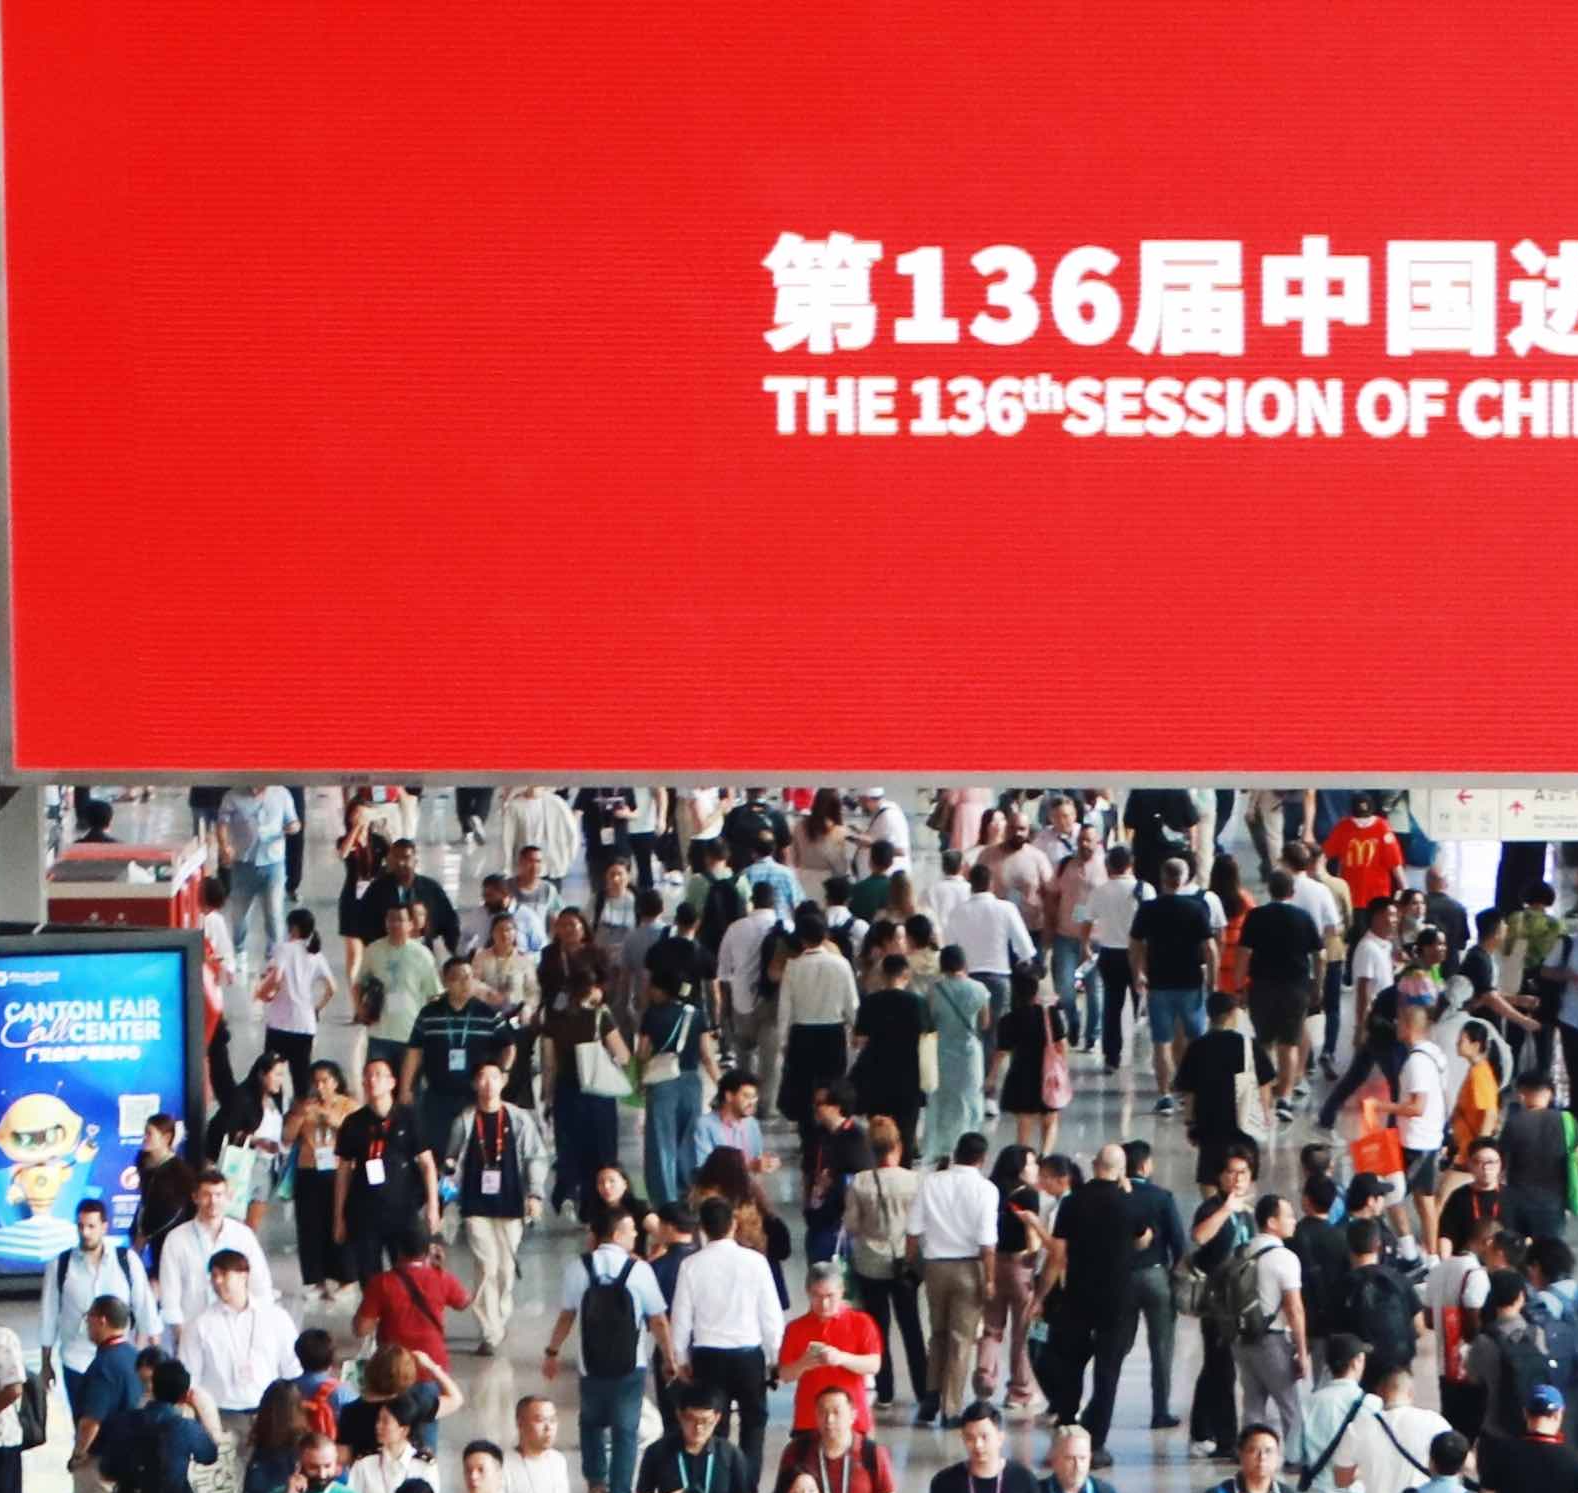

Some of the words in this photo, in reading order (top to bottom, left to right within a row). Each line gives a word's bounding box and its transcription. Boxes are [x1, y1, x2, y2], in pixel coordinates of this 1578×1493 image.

[764, 376, 899, 437] THE
[1357, 377, 1449, 438] OF
[4, 999, 104, 1024] CANTON
[110, 997, 161, 1019] FAIR
[0, 1016, 70, 1049] Call
[70, 1019, 161, 1042] CENTER
